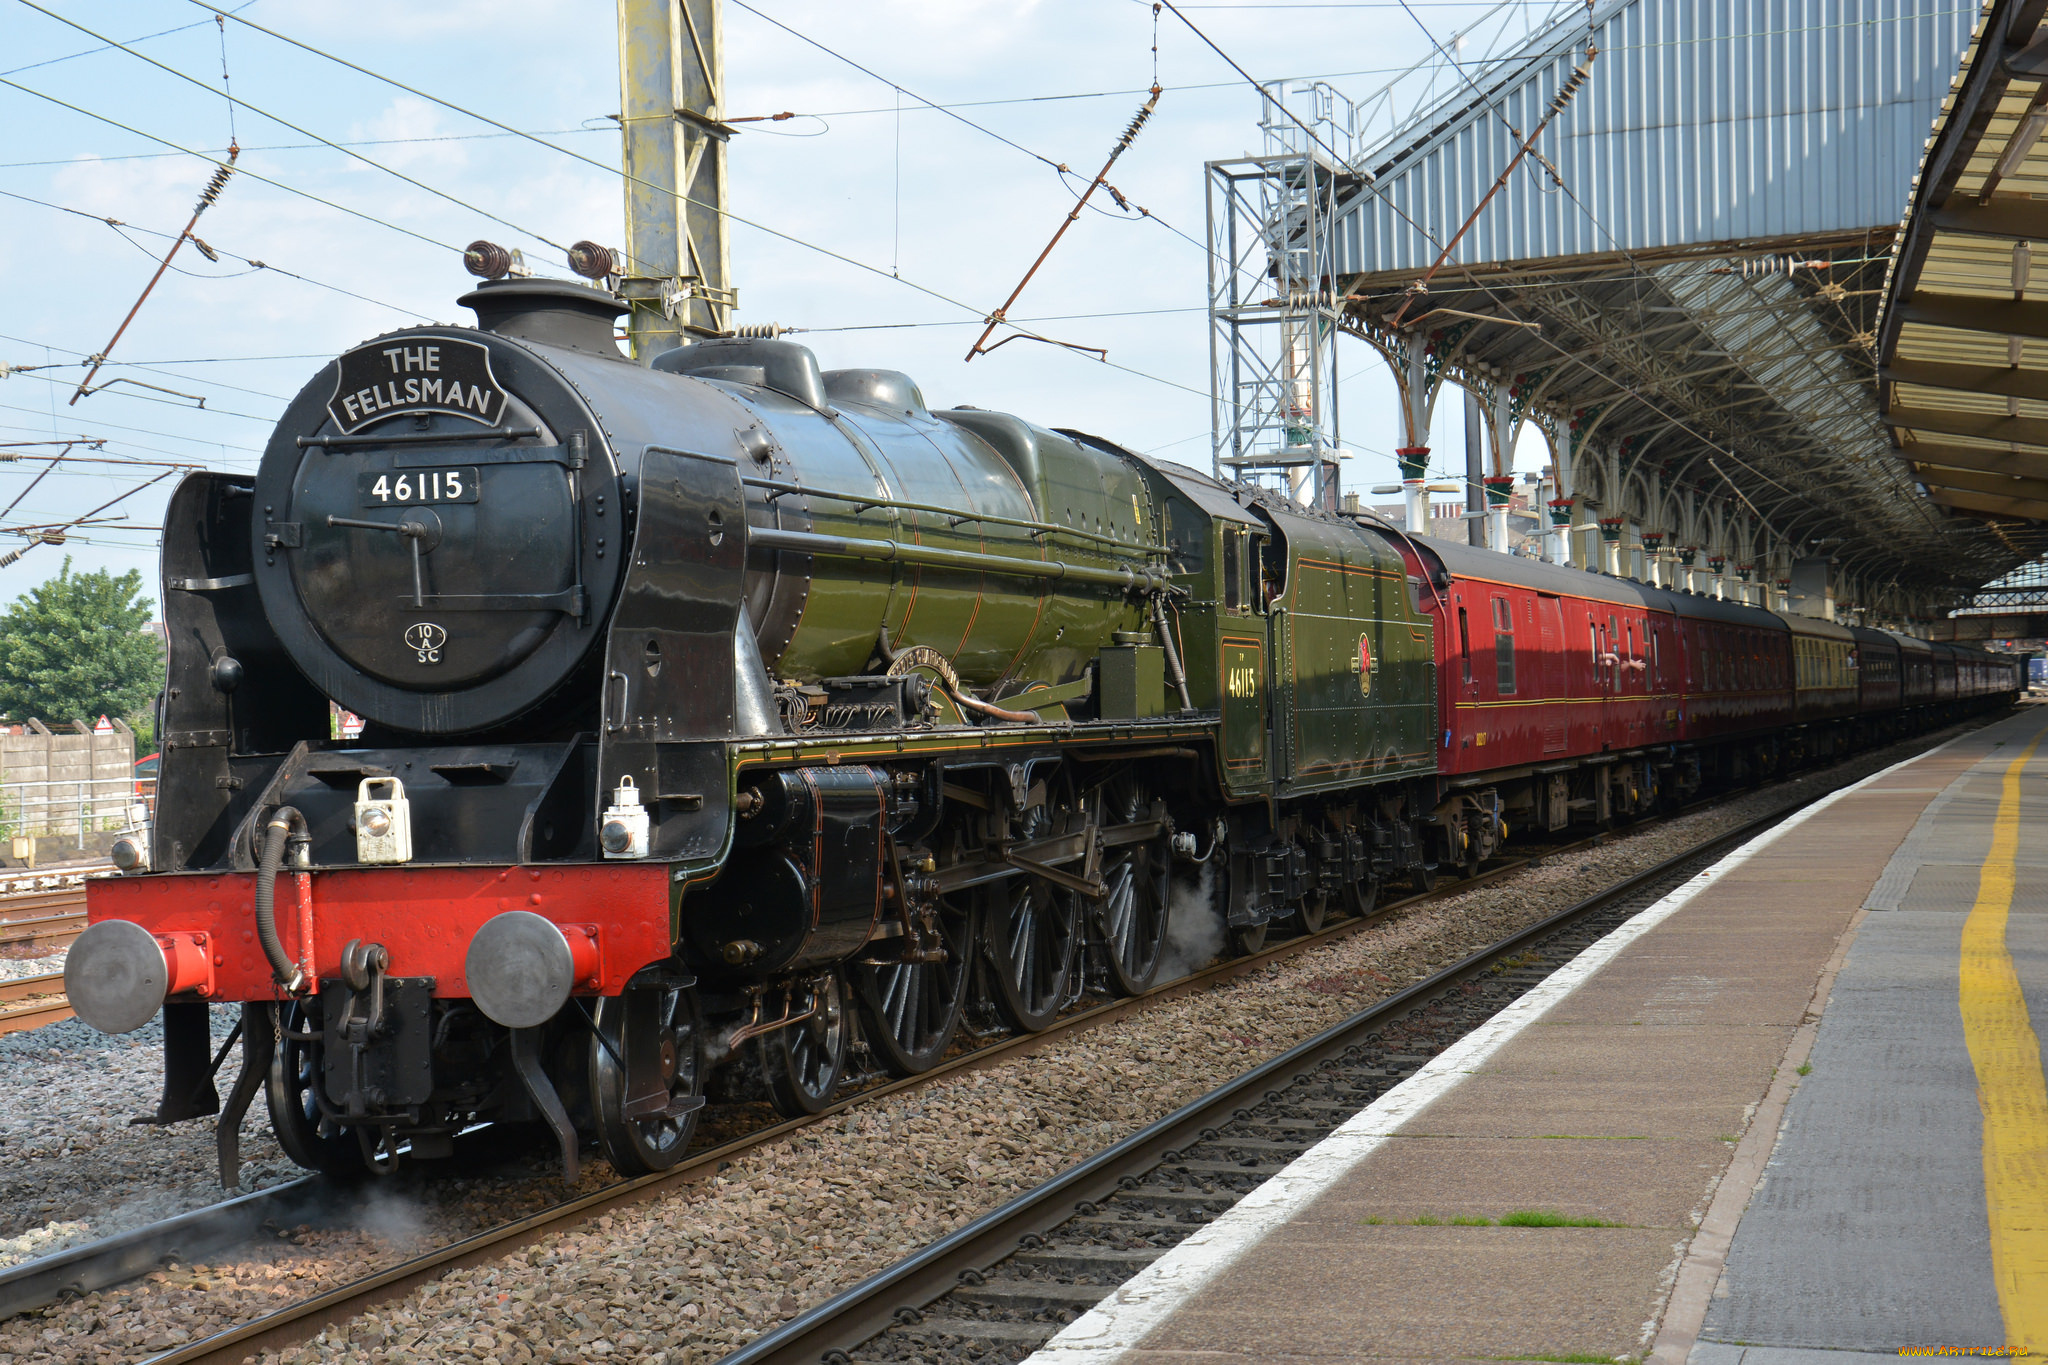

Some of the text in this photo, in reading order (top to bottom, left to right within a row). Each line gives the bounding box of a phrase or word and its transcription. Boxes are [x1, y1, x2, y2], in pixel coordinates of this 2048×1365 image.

[383, 346, 440, 373] THE
[342, 378, 491, 421] FELLSMAN
[372, 472, 463, 502] 46115
[418, 625, 432, 638] 10
[421, 638, 431, 649] A
[417, 650, 439, 663] SC
[1229, 667, 1255, 698] 46115
